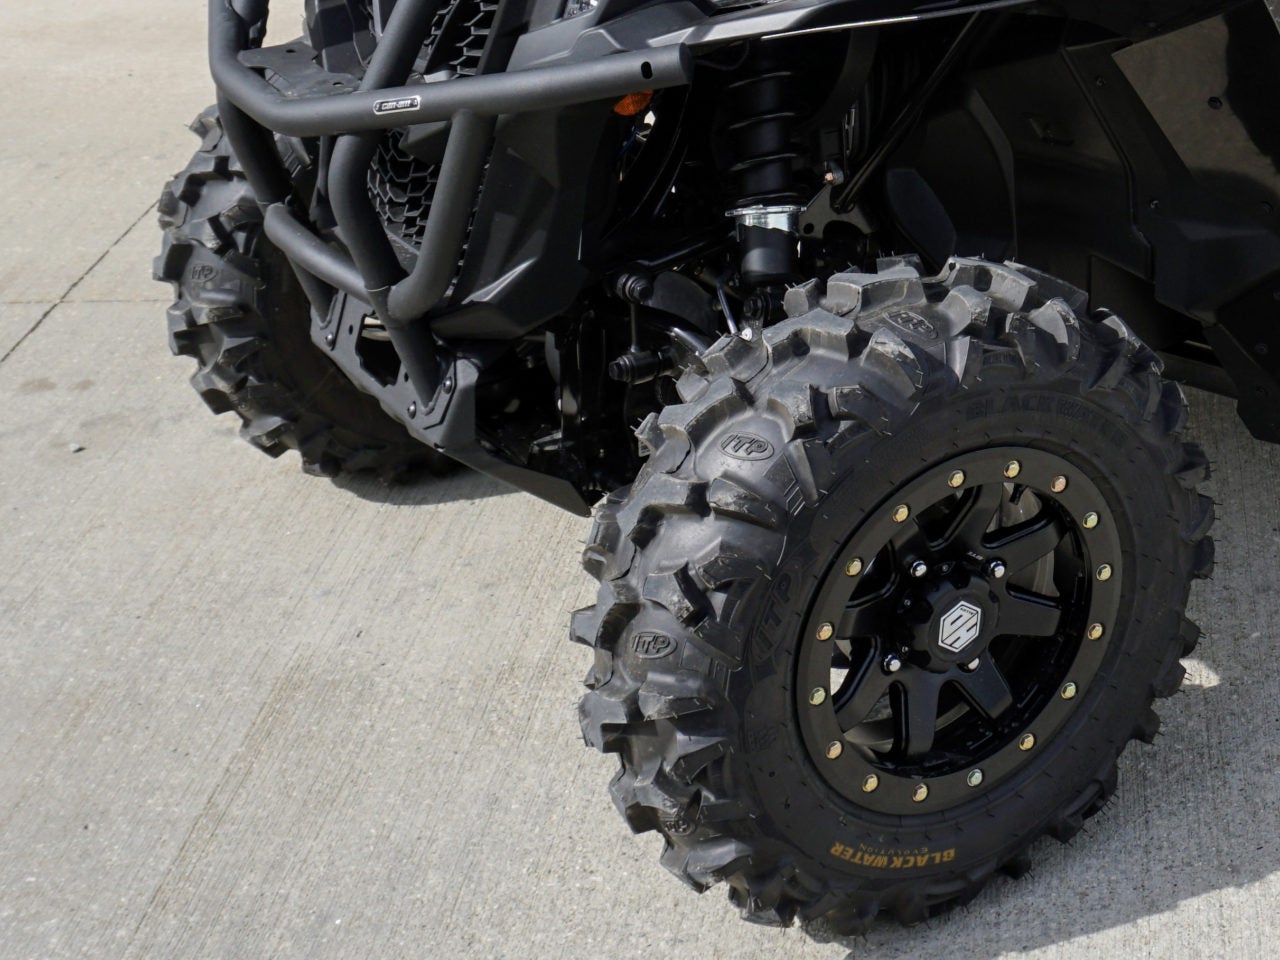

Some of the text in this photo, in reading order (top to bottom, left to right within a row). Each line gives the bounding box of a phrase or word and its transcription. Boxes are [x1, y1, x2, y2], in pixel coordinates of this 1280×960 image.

[190, 265, 214, 280] ITP
[720, 433, 769, 456] ITP
[631, 634, 671, 654] ITP
